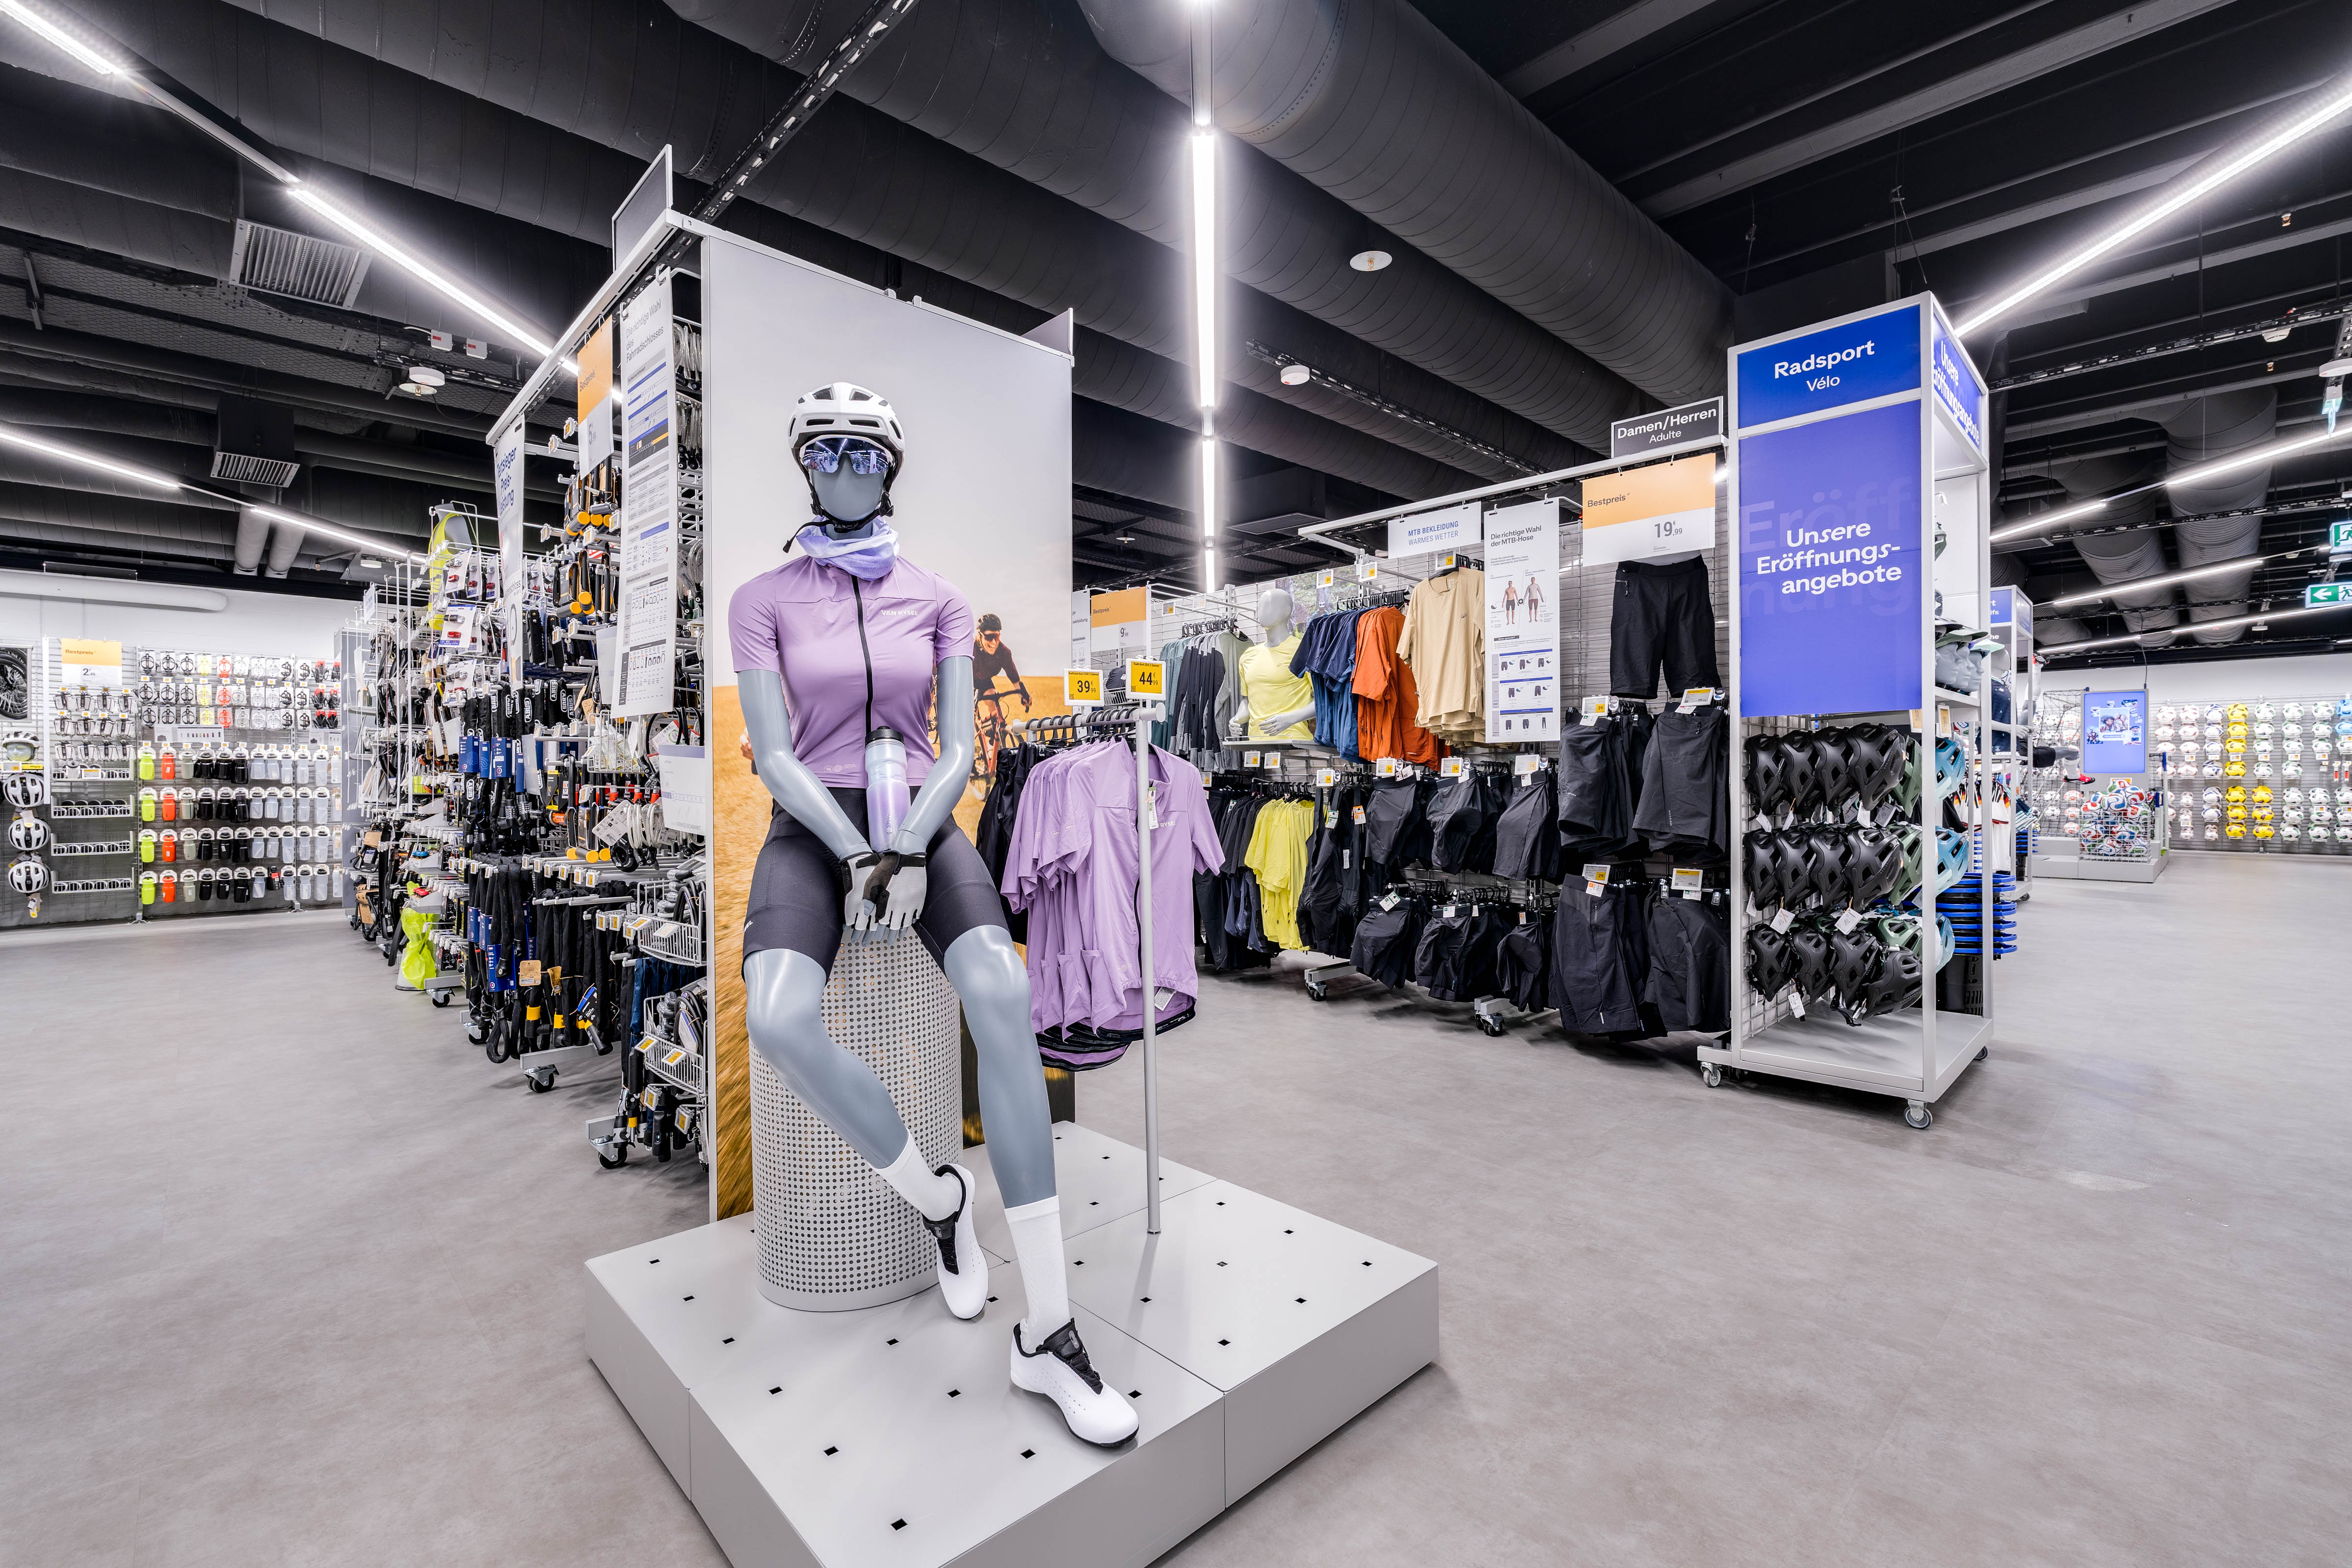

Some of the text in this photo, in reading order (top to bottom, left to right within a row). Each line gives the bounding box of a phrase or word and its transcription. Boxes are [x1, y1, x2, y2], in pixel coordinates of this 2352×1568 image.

[649, 298, 662, 316] Wahl
[1774, 340, 1875, 379] Radsport
[1941, 340, 1959, 387] Unsere
[580, 370, 595, 392] Bestpreis
[1806, 375, 1841, 392] Vélo
[1617, 407, 1717, 440] Damen/Herren
[1648, 428, 1682, 443] Adulte
[499, 489, 514, 516] Leistung
[1588, 494, 1626, 508] Bestpreis
[1408, 521, 1459, 537] MTB BEKLEIDUNG
[1501, 529, 1525, 539] richtige
[1525, 525, 1542, 534] Wahl
[1787, 523, 1871, 547] Unsere
[1408, 530, 1459, 546] WARMES WETTER
[1501, 535, 1534, 545] MTB-Hose
[1757, 543, 1900, 575] Eröffnungs-
[1782, 565, 1902, 595] angebote
[1077, 680, 1090, 693] 39
[1139, 671, 1152, 685] 44
